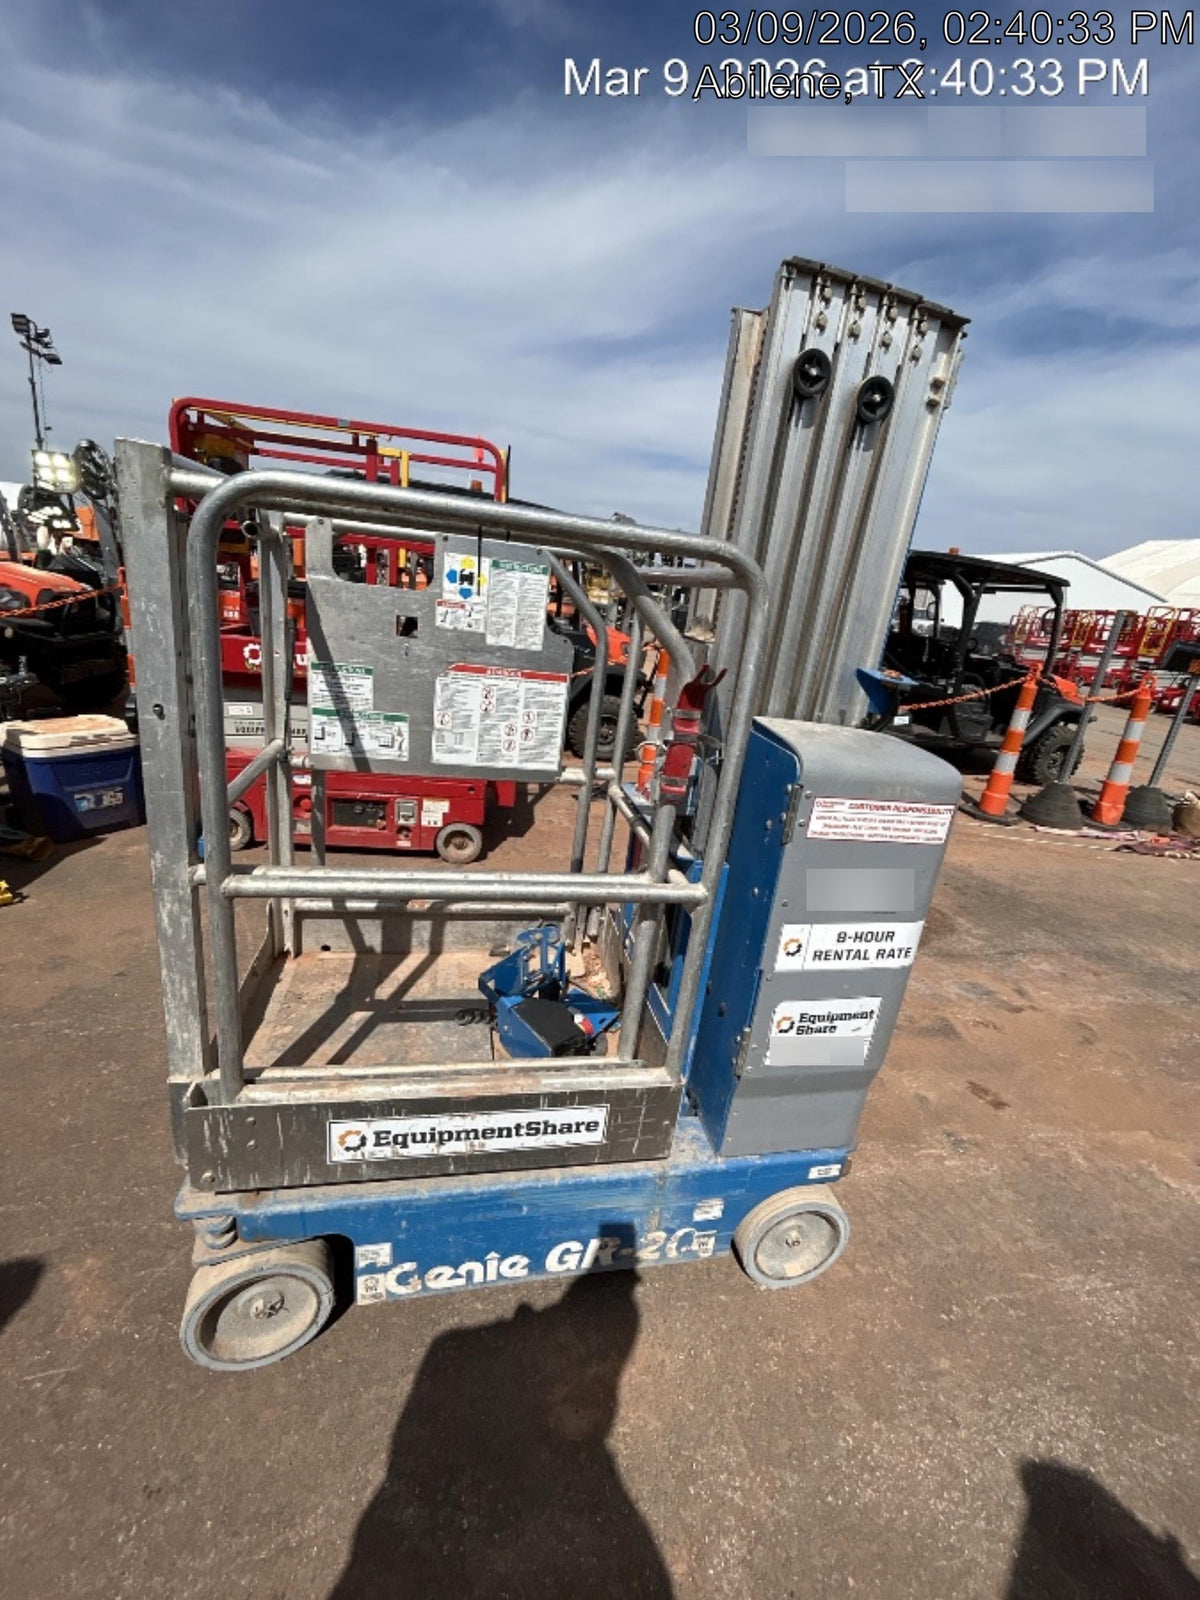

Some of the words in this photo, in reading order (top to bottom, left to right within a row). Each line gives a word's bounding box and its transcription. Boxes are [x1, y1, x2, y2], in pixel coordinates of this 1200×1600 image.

[836, 931, 896, 943] 8-HOUR
[812, 949, 871, 962] RENTAL
[875, 947, 913, 960] RATE
[798, 1009, 875, 1025] Equipment
[796, 1024, 838, 1036] Share
[372, 1119, 600, 1149] EquipmentShare
